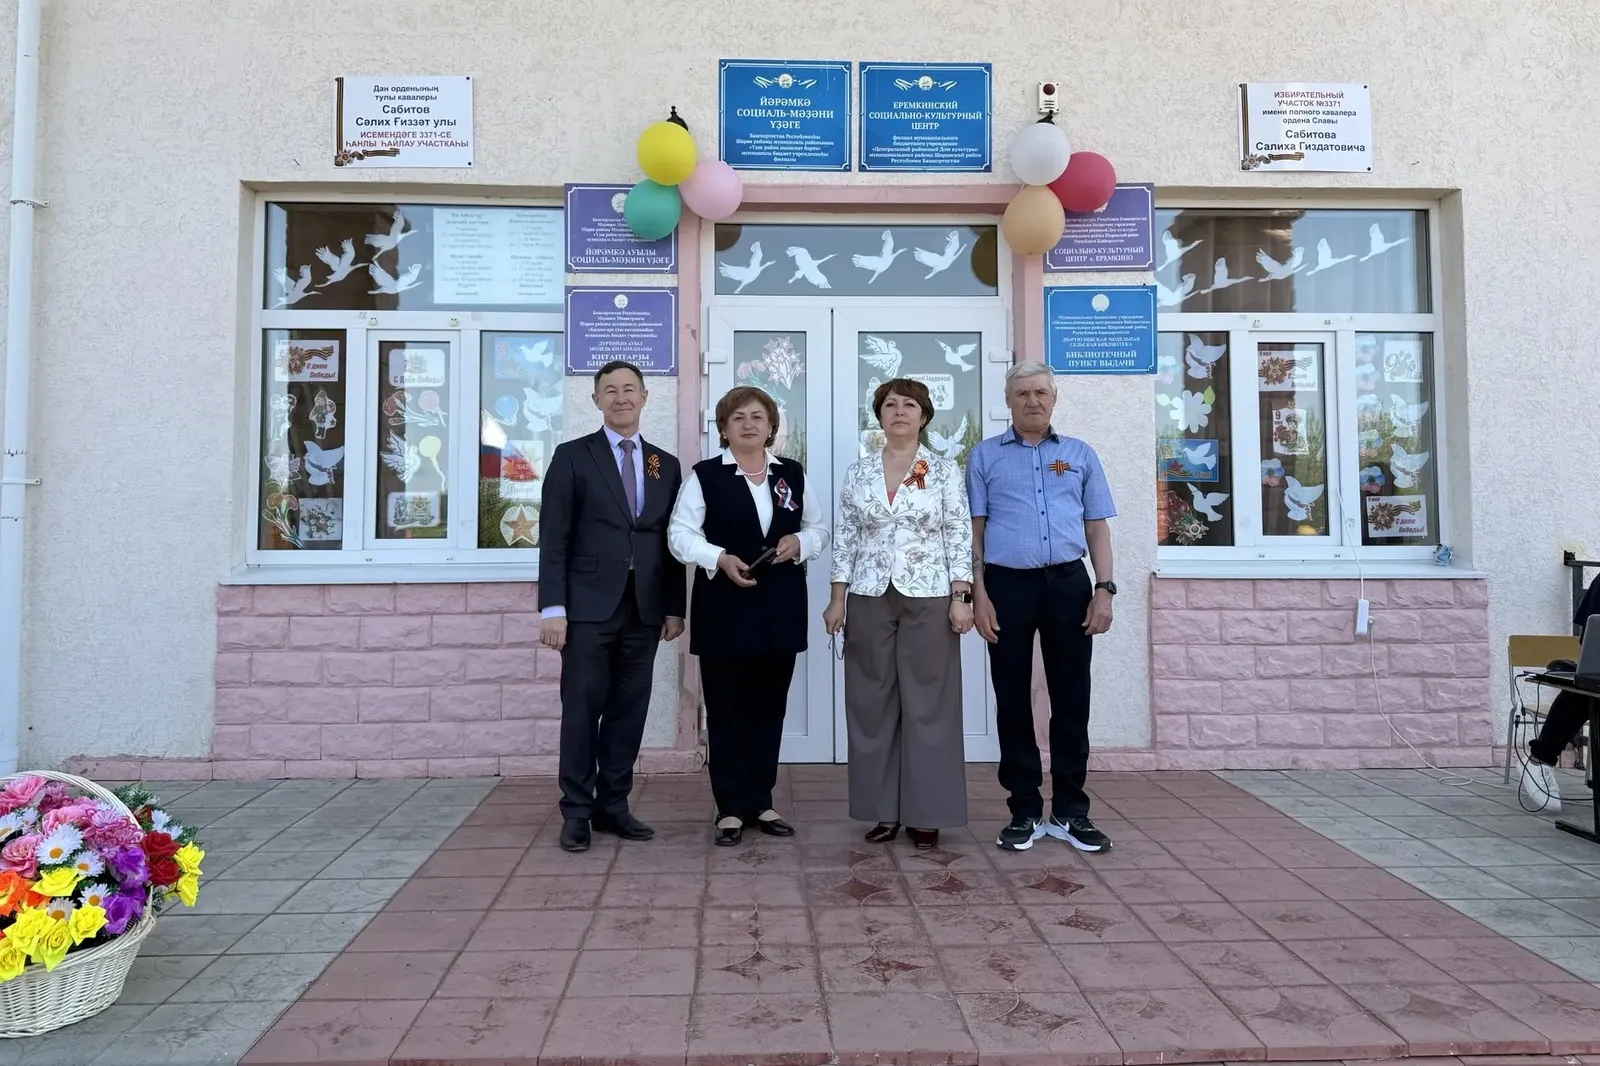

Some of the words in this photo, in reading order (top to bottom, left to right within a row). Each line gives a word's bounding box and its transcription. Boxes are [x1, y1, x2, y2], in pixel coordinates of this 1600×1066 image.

[760, 96, 810, 106] ЙӘРӘМКӘ
[894, 101, 958, 109] ЕРЕМКИНСКИЙ
[382, 104, 430, 114] Сабитов
[737, 109, 834, 119] СОЦИАЛЬ-МӘҘӘНИ
[869, 111, 982, 120] СОЦИАЛЬНО-КУЛЬТУРНЫЙ
[356, 117, 390, 126] Сәлих
[434, 119, 456, 128] улы
[770, 121, 800, 130] ҮҘӘГЕ
[1286, 130, 1336, 139] Сабитова
[1256, 142, 1295, 150] Салиха
[1300, 142, 1366, 152] Гиздатовича
[1055, 246, 1144, 254] СОЦИАЛЬНО-КУЛЬТУРНЫЙ
[1066, 350, 1137, 358] БИБЛИОТЕЧНЫЙ
[1276, 411, 1280, 419] 9
